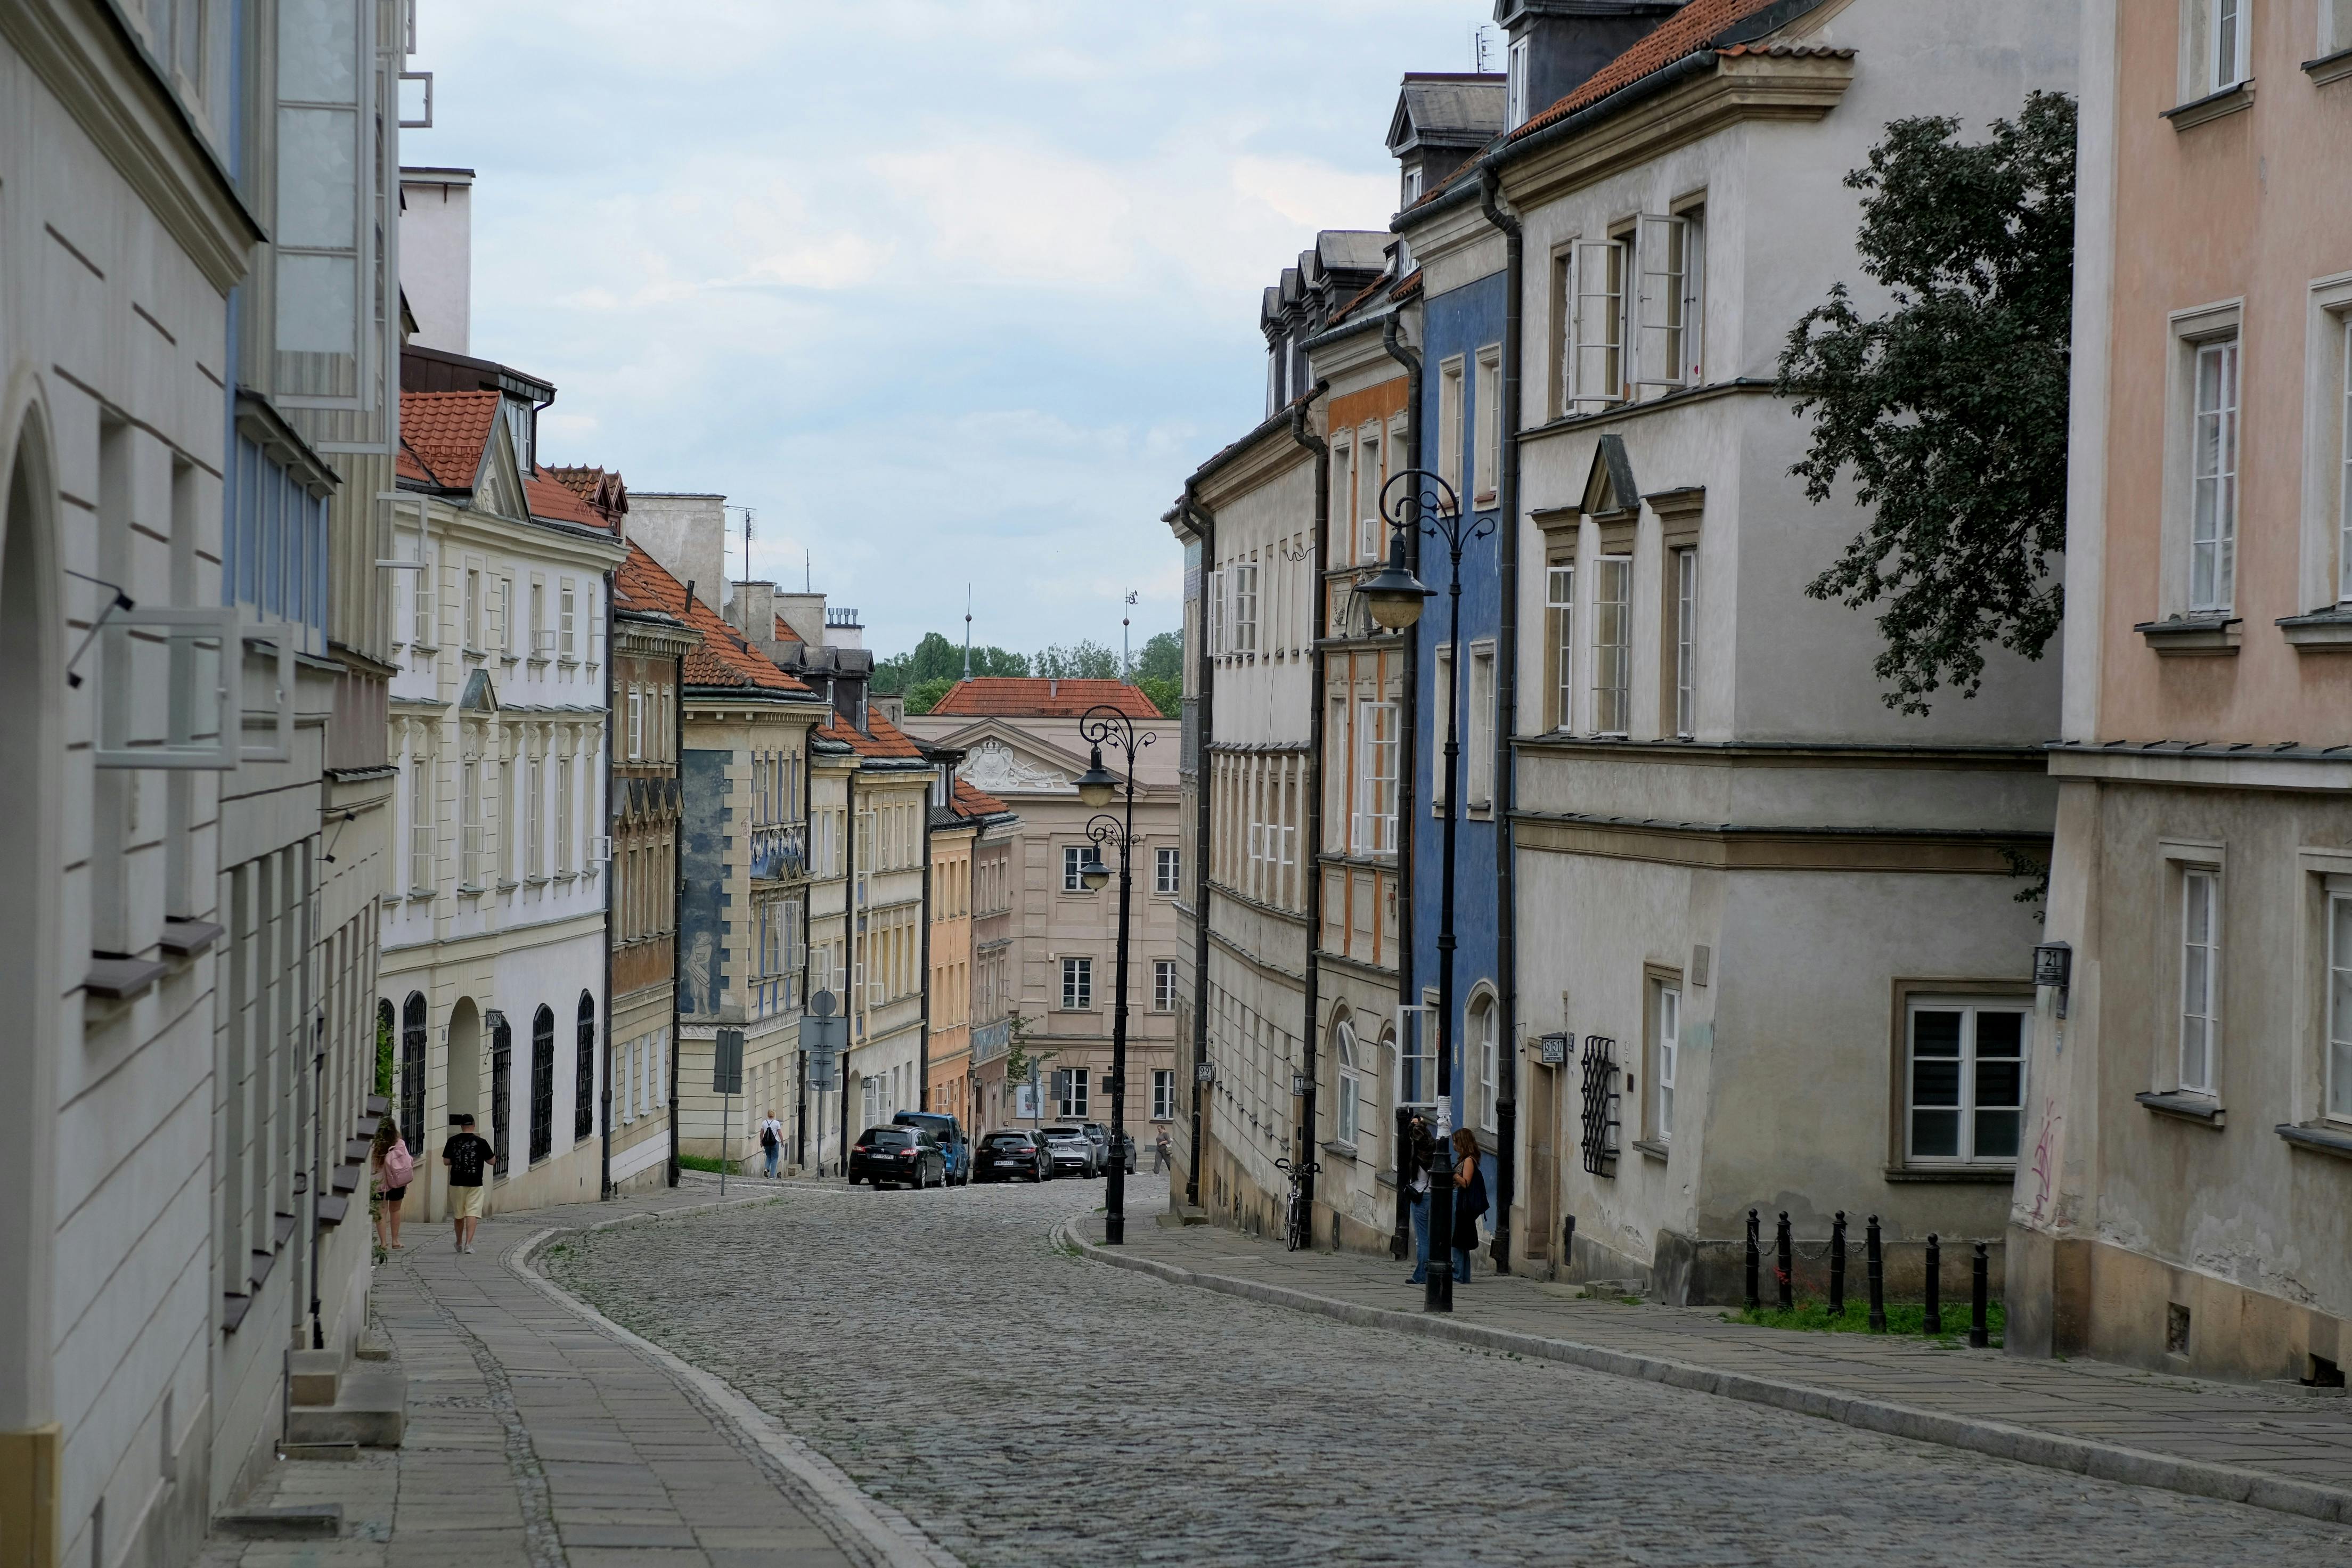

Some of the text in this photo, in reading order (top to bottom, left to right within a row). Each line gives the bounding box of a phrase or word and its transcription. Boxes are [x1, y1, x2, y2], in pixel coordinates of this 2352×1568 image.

[2045, 951, 2057, 967] 21
[1544, 1040, 1563, 1051] 13 15 17
